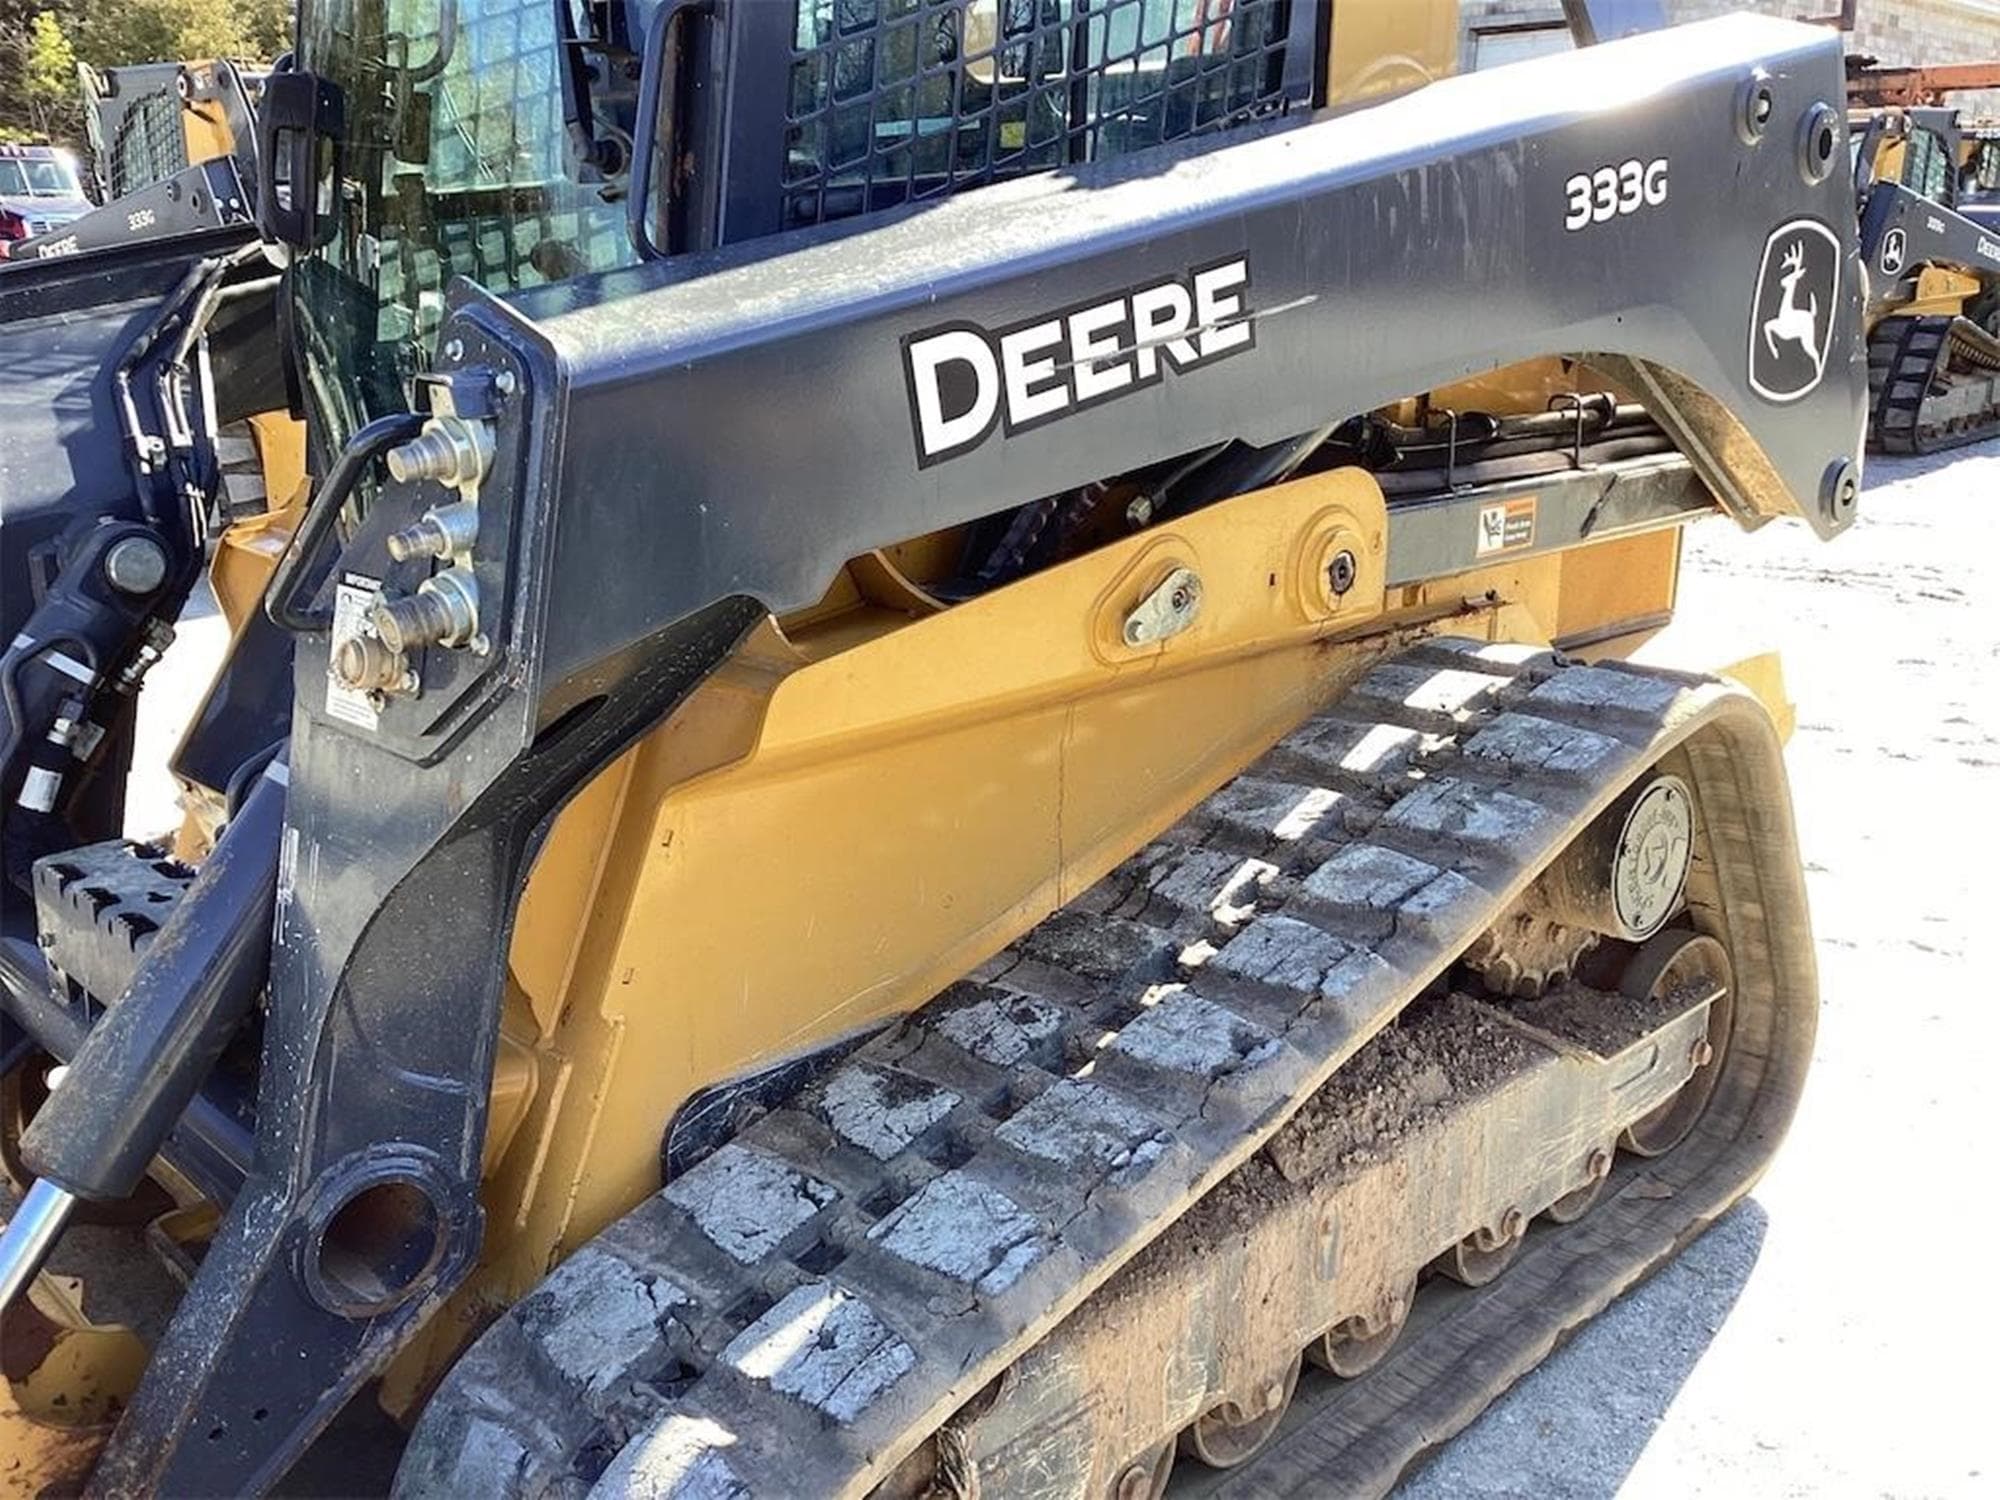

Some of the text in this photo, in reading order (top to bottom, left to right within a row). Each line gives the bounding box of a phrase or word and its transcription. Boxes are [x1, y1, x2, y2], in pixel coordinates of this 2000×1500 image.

[127, 209, 155, 231] 333G
[1566, 159, 1668, 230] 333G
[909, 259, 1251, 456] DEERE
